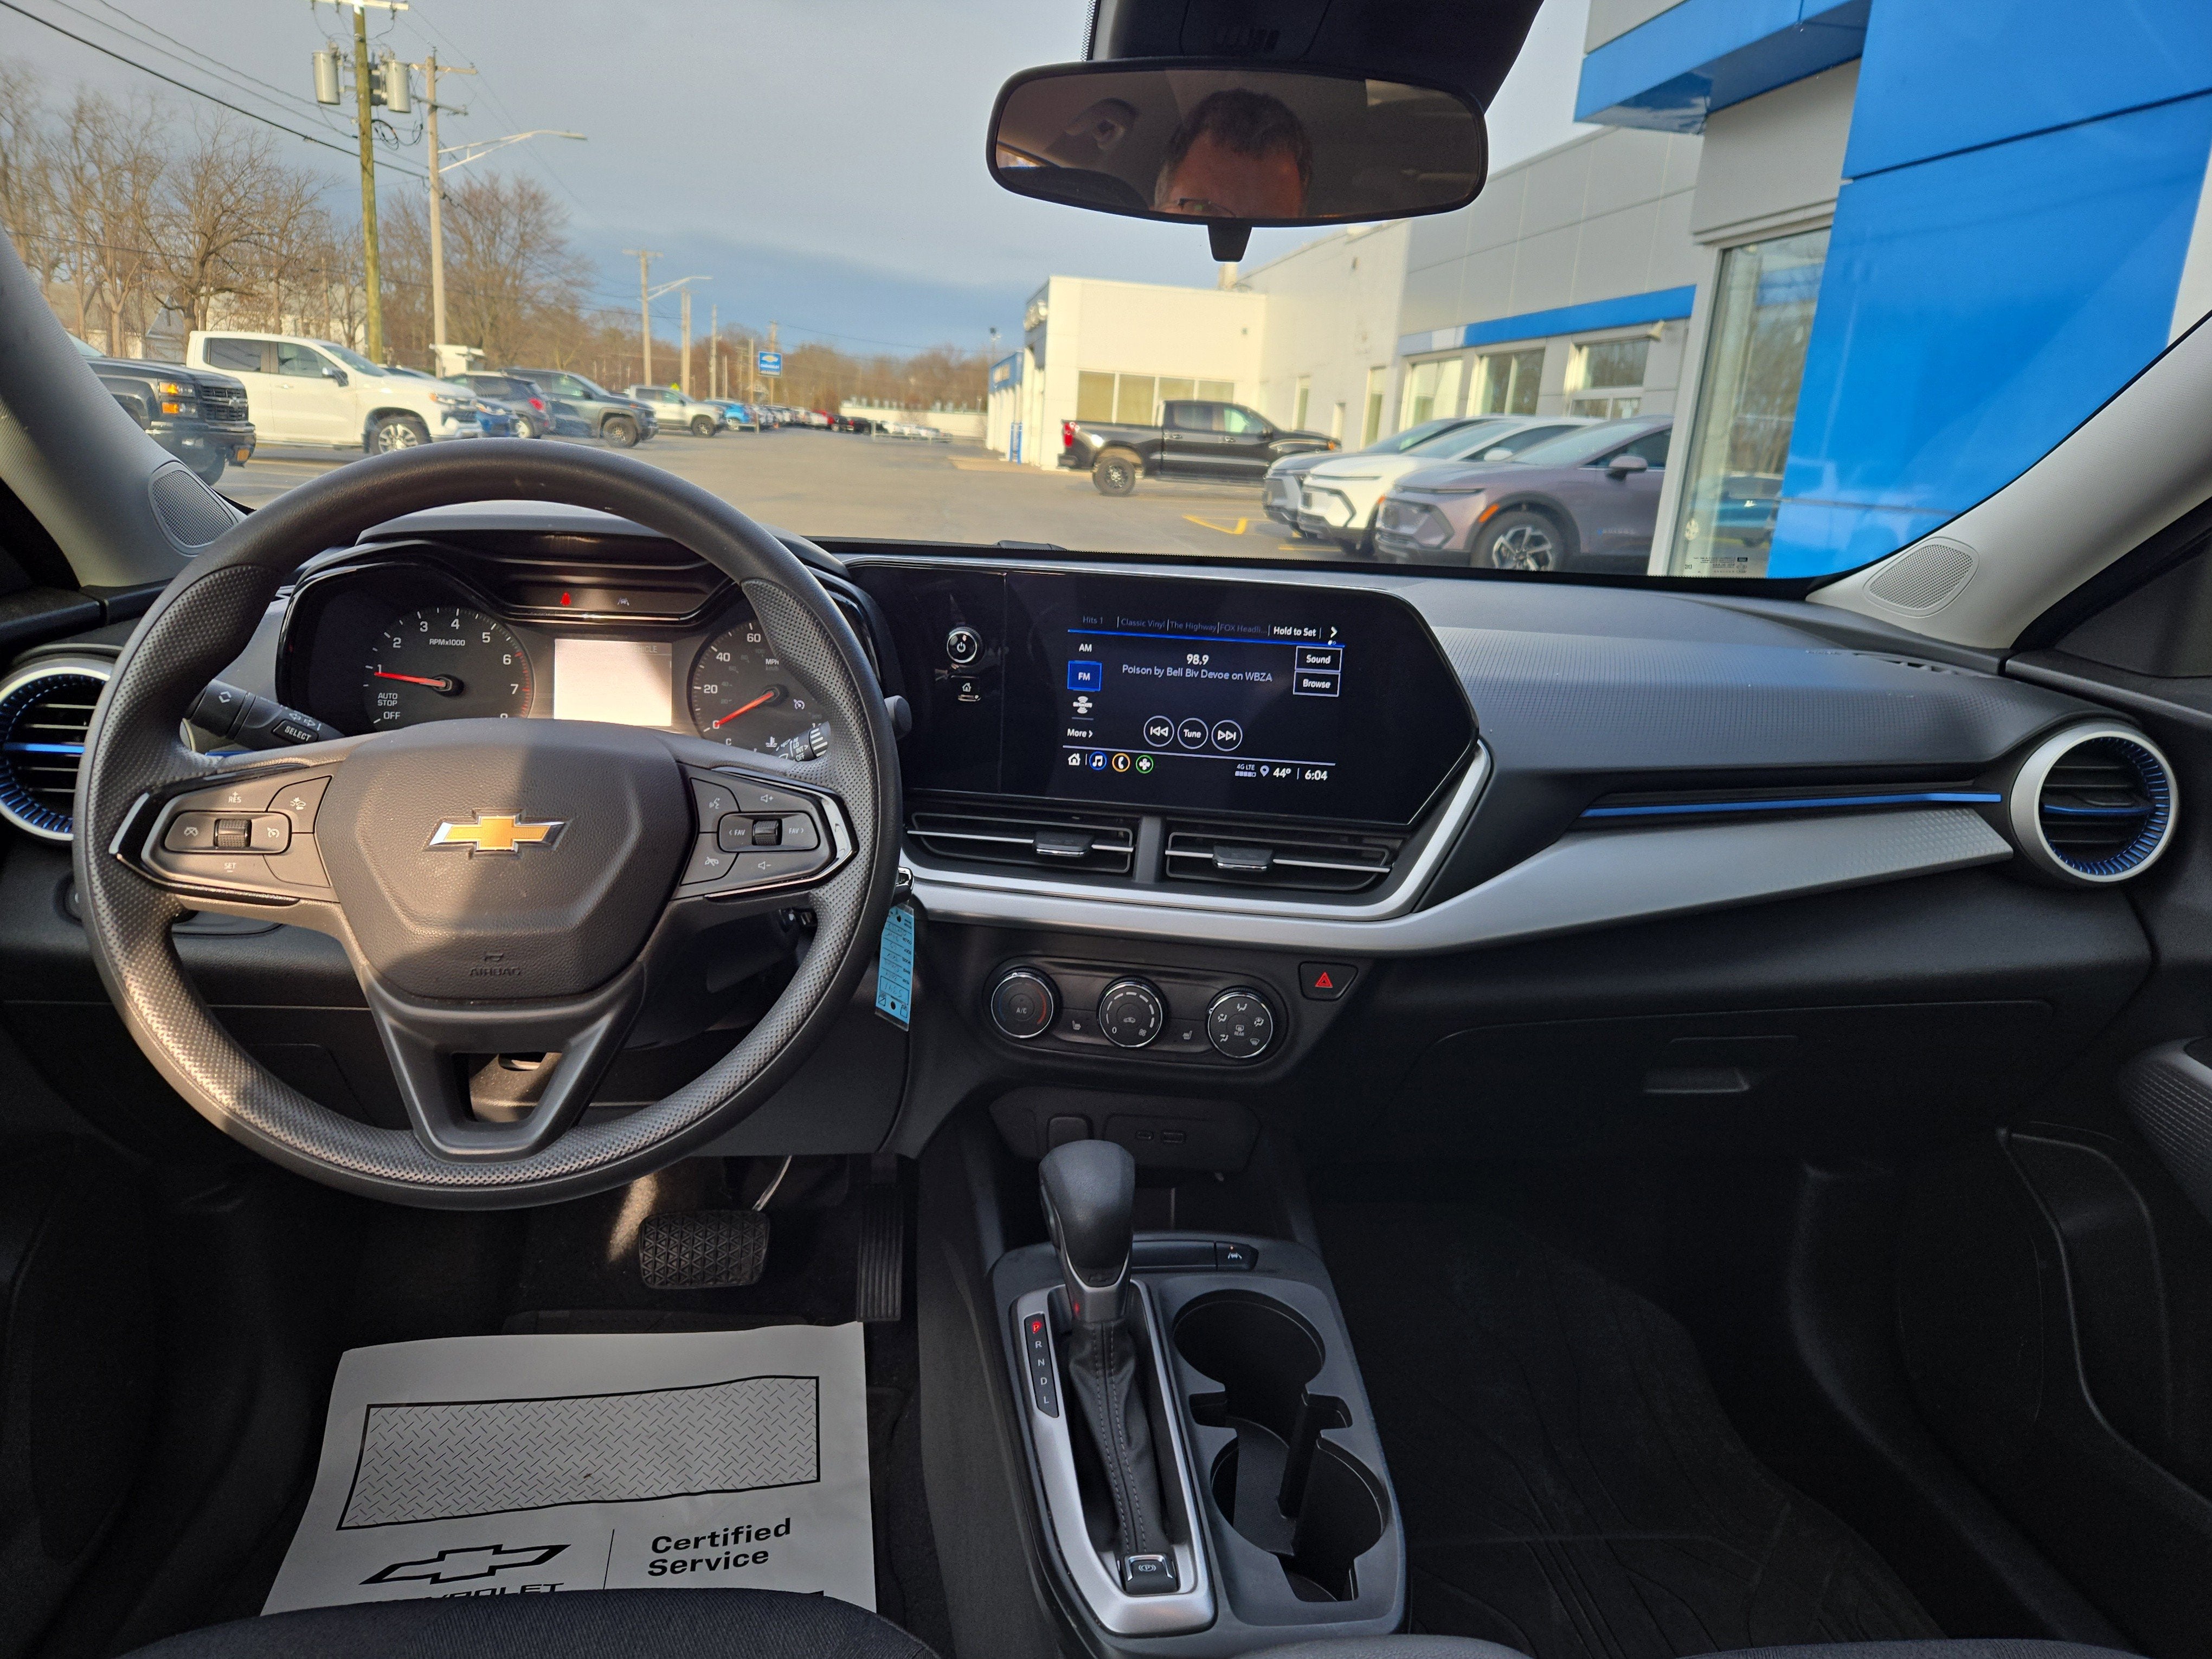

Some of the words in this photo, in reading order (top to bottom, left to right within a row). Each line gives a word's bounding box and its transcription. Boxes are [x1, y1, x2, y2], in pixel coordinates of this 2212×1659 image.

[451, 619, 460, 629] 4
[1083, 616, 1098, 624] Hits
[1121, 618, 1146, 627] Classic
[1148, 620, 1166, 629] Vinyl
[420, 621, 428, 632] 3
[1170, 621, 1183, 629] The
[1186, 622, 1217, 633] Highway
[1274, 626, 1292, 635] Hold
[1293, 628, 1302, 636] to
[1303, 627, 1316, 637] Set
[393, 637, 402, 648] 2
[482, 632, 491, 643] 5
[747, 633, 761, 643] 60
[1079, 644, 1092, 652] AM
[503, 654, 511, 665] 6
[716, 652, 731, 662] 40
[1187, 653, 1209, 665] 98.9
[1306, 654, 1331, 664] Sound
[377, 664, 382, 673] 1
[1122, 664, 1152, 675] Poison
[1154, 666, 1165, 678] by
[1167, 667, 1183, 677] Bell
[1186, 668, 1199, 678] Biv
[1201, 669, 1229, 679] Devoe
[1245, 672, 1272, 682] WBZA
[1078, 672, 1090, 681] FM
[1303, 678, 1331, 689] Browse
[510, 684, 519, 695] 7
[704, 684, 718, 694] 20
[377, 692, 398, 700] AUTO
[383, 712, 401, 720] OFF
[284, 726, 312, 742] SELECT
[1067, 728, 1087, 738] More
[1183, 729, 1201, 738] Tune
[725, 738, 732, 746] C
[1304, 770, 1328, 781] 6:04
[1033, 1323, 1039, 1332] P
[1038, 1358, 1045, 1367] N
[1040, 1377, 1047, 1385] D
[651, 1517, 791, 1554] Certified
[647, 1551, 769, 1577] Service
